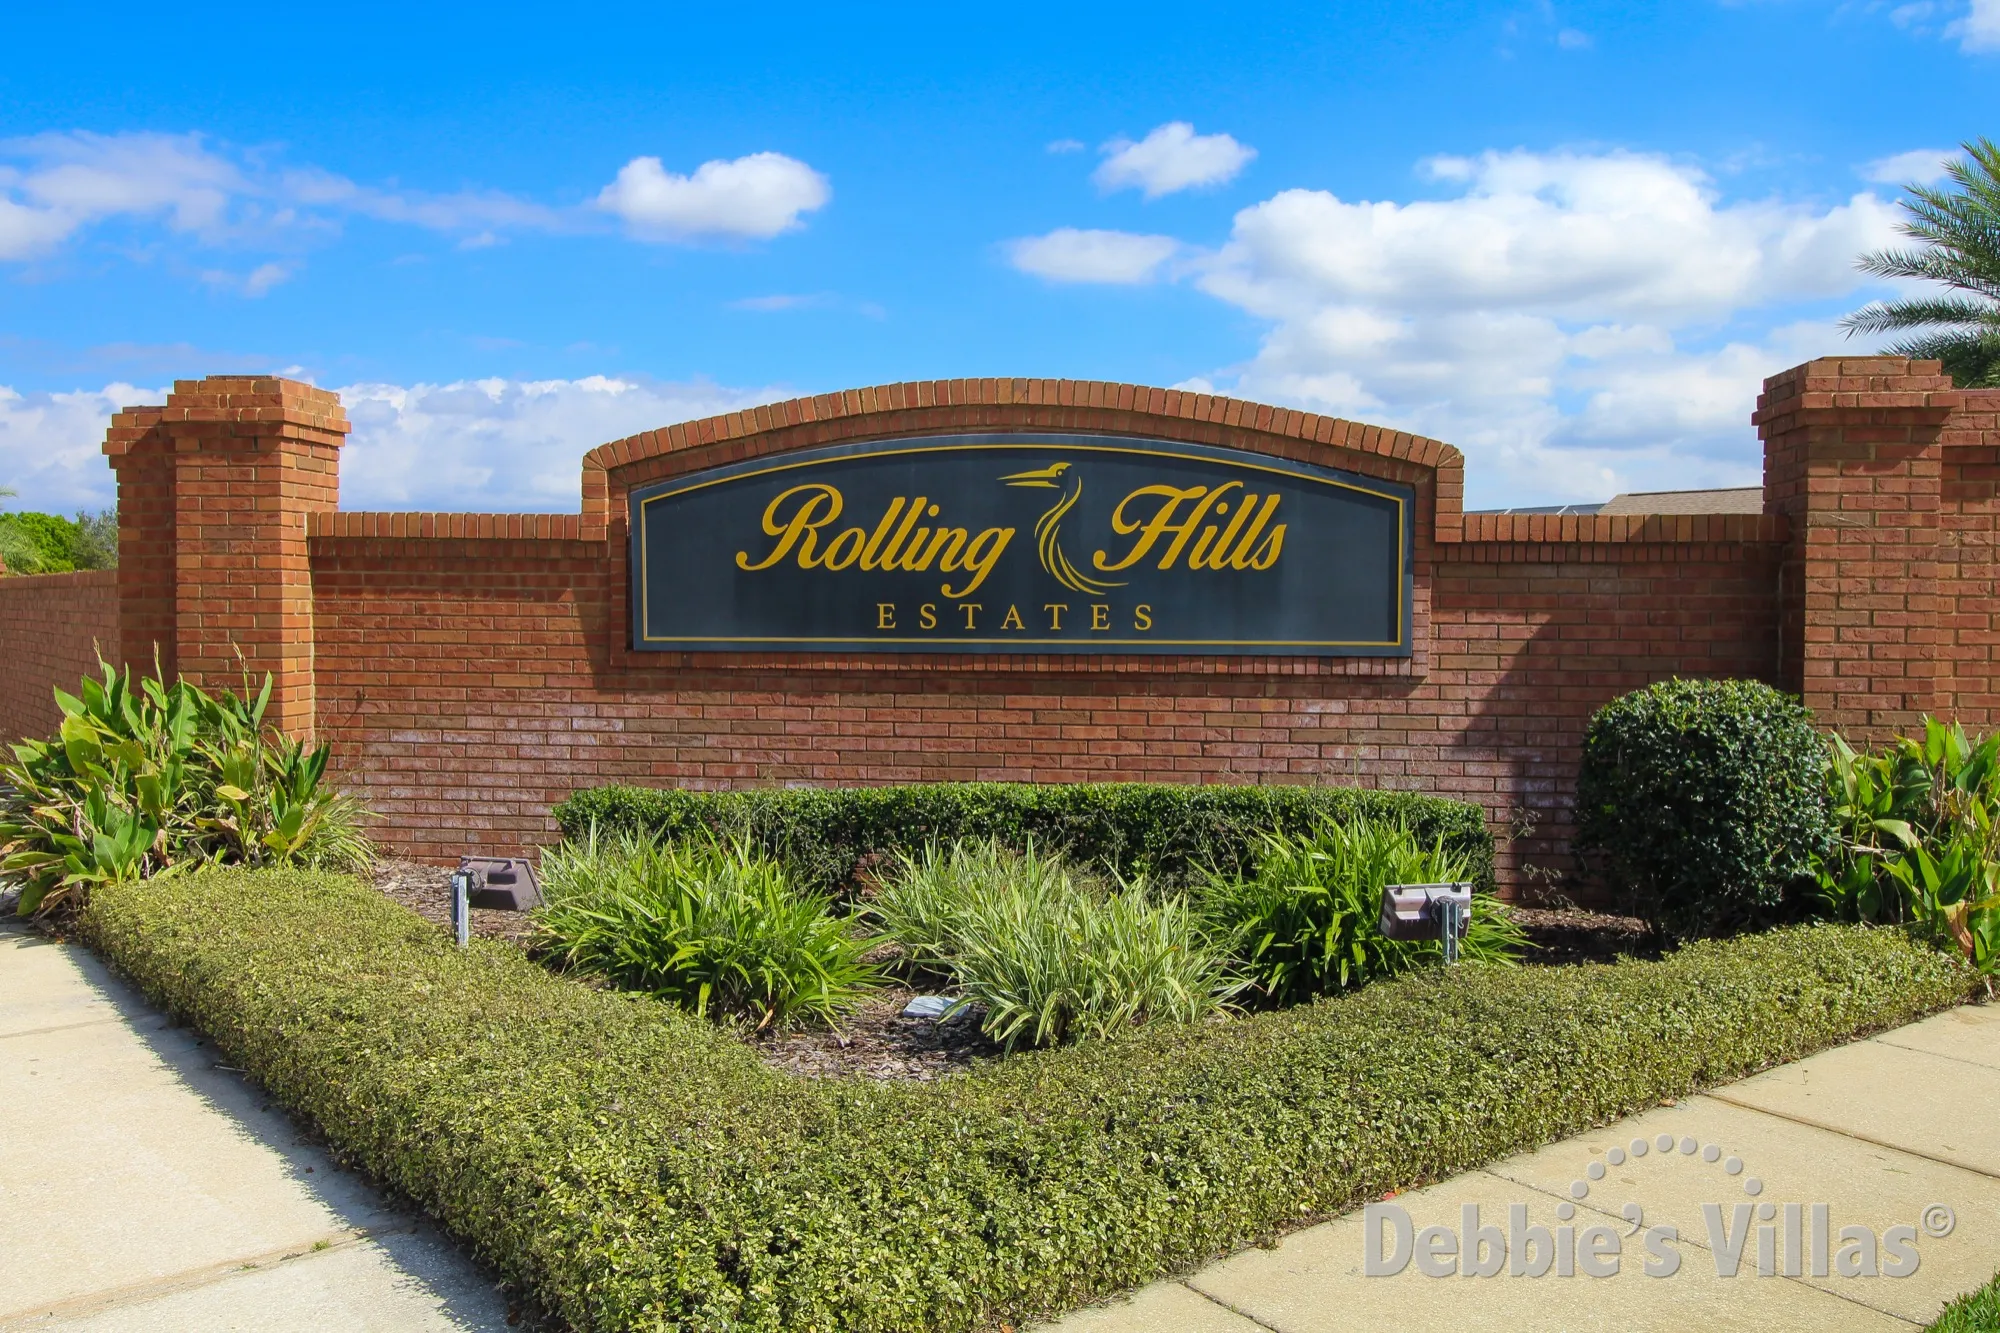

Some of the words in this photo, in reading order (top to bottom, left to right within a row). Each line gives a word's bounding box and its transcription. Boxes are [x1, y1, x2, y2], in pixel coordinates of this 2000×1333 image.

[735, 483, 1016, 599] Rolling
[1092, 480, 1288, 571] Hills
[876, 602, 1154, 632] ESTATES
